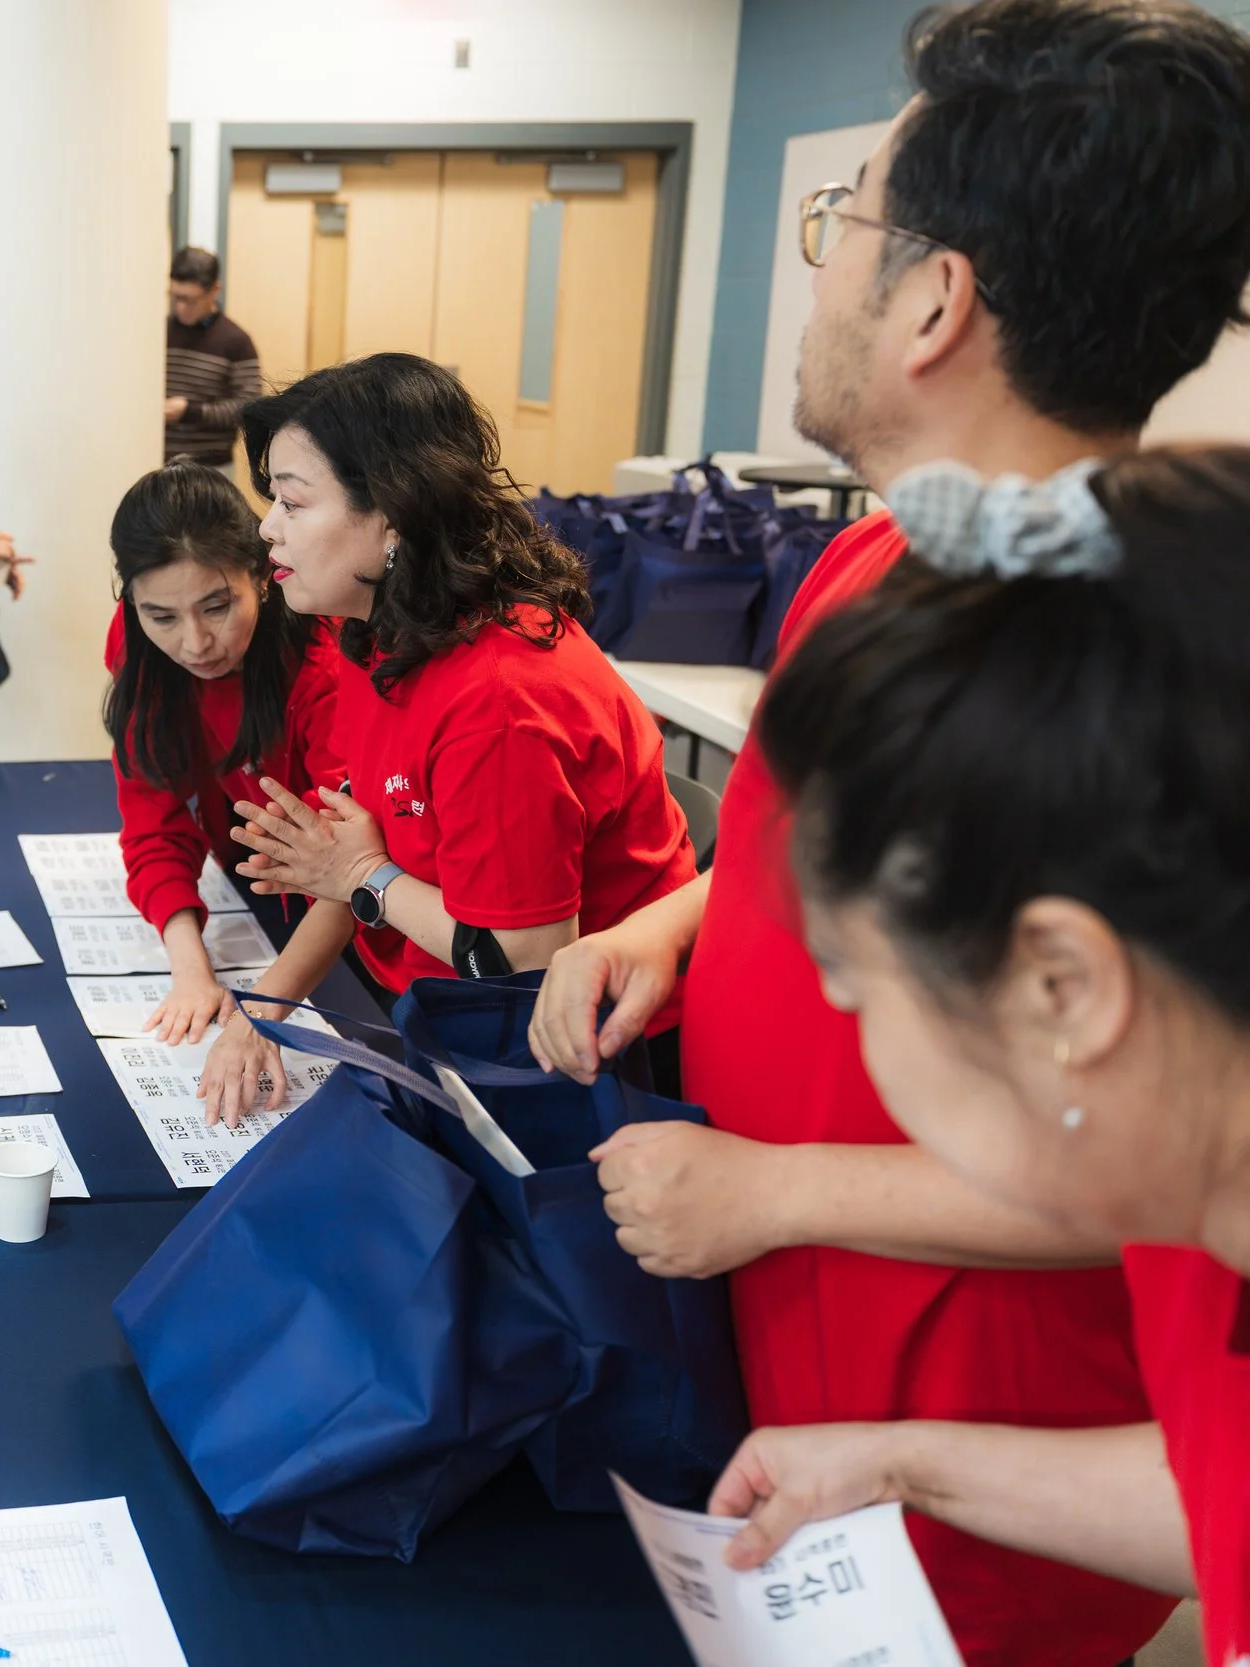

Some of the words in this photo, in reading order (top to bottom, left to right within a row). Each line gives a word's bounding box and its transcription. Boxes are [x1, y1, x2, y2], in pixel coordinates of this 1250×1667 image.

[160, 1117, 191, 1141] 김유진
[181, 1151, 212, 1174] 서현덕
[763, 1555, 866, 1622] 윤수미
